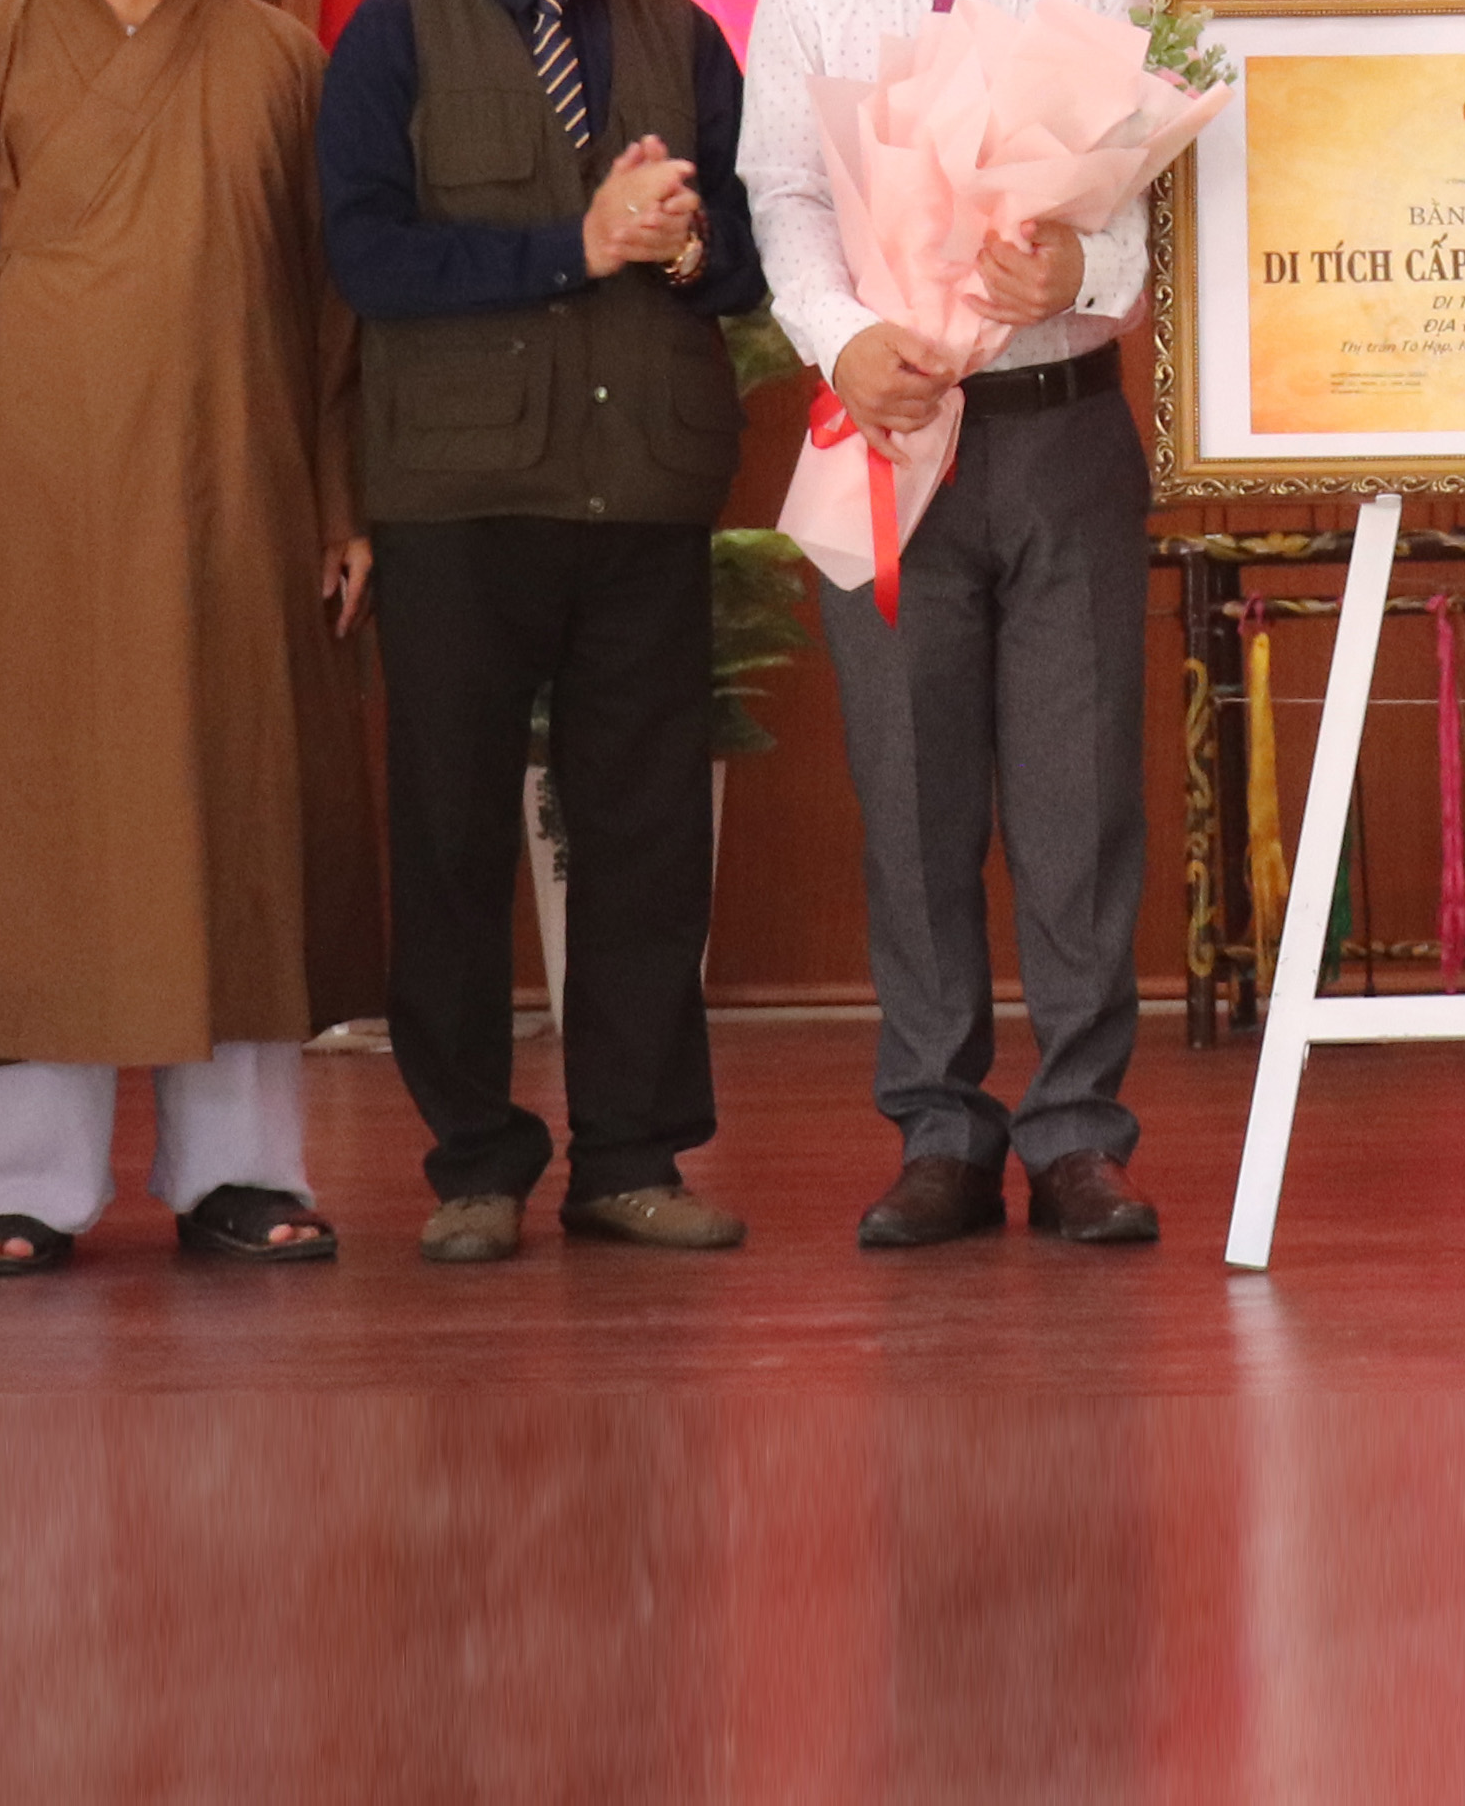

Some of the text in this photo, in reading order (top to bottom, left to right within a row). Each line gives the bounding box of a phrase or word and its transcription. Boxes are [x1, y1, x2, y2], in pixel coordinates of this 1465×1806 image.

[1262, 250, 1301, 284] DI
[1310, 239, 1393, 283] TÍCH
[1432, 294, 1454, 310] DI
